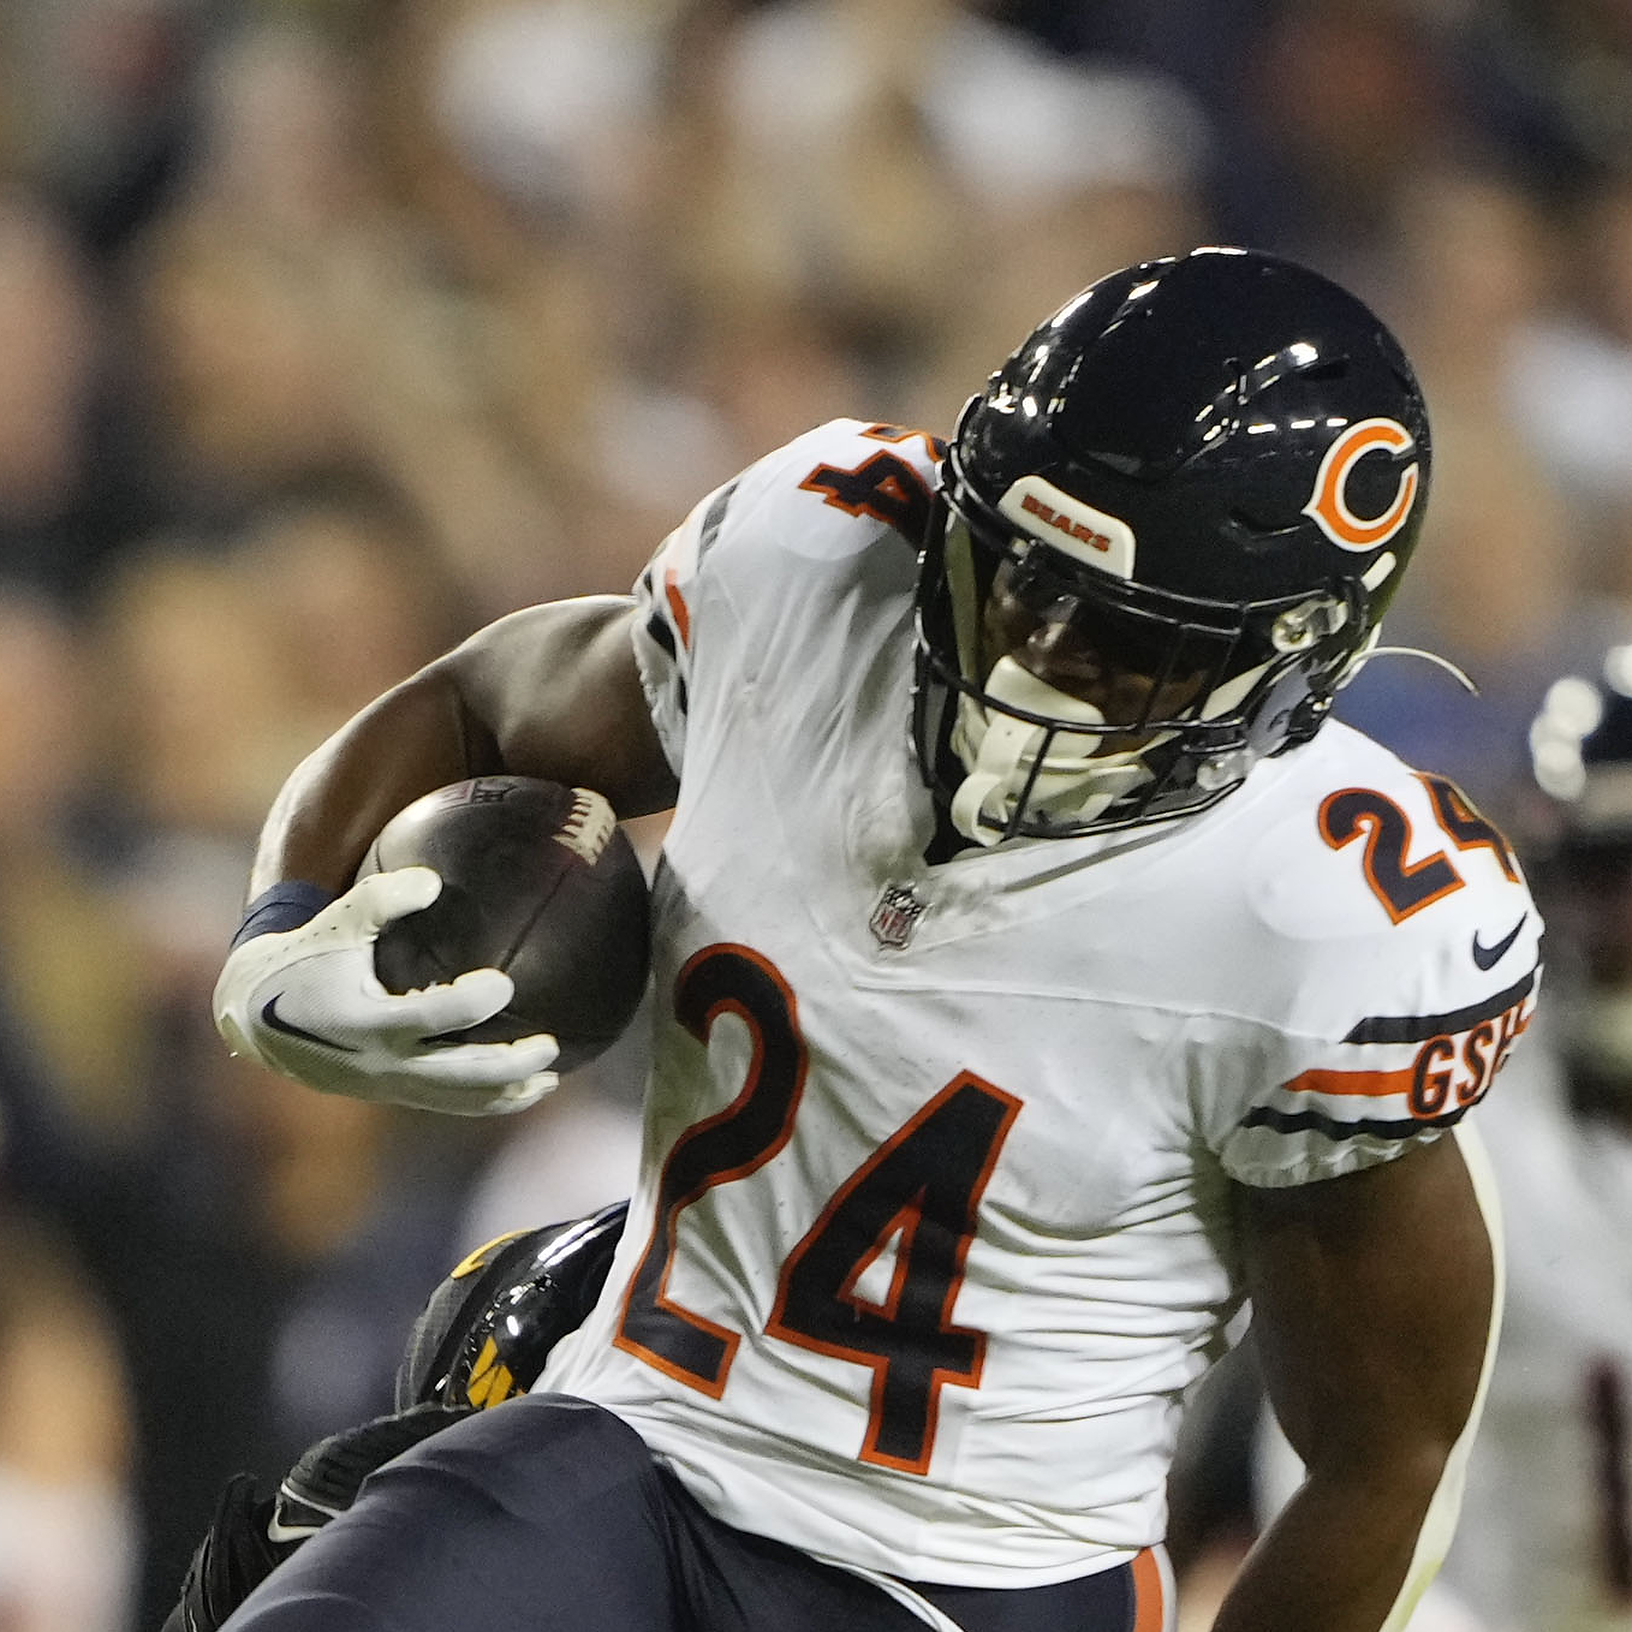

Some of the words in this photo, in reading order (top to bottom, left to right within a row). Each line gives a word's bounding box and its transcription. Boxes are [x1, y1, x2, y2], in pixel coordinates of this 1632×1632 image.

[1021, 494, 1111, 553] BEARS
[1300, 417, 1419, 552] C
[1317, 771, 1522, 927] 24
[613, 942, 1025, 1476] 24
